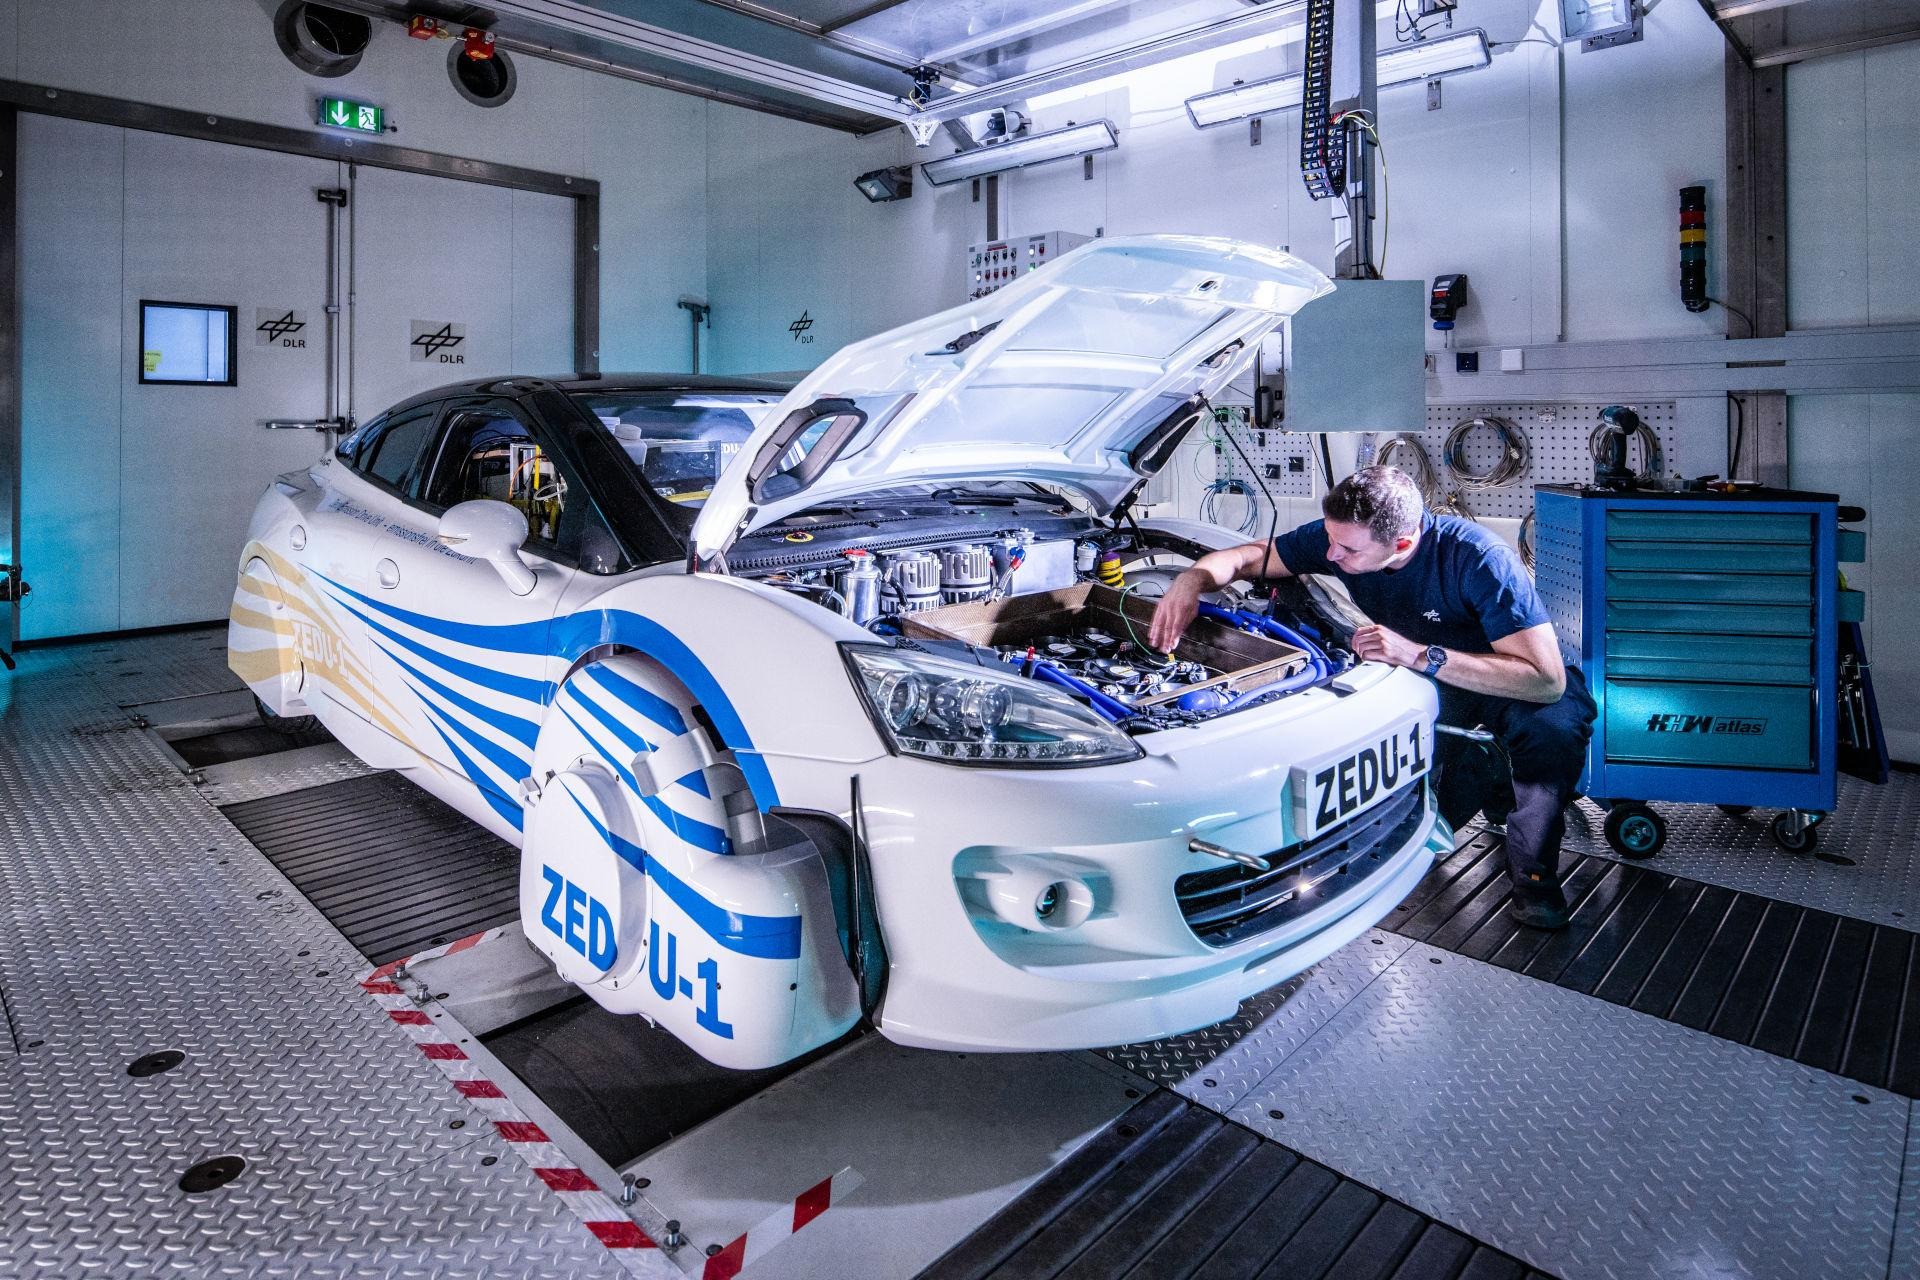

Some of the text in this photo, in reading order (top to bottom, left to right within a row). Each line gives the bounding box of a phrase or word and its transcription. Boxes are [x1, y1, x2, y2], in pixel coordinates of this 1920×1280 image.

[283, 339, 305, 348] DLR
[440, 354, 464, 364] DLR
[1716, 720, 1762, 733] atlas
[1315, 722, 1426, 832] ZEDU-1
